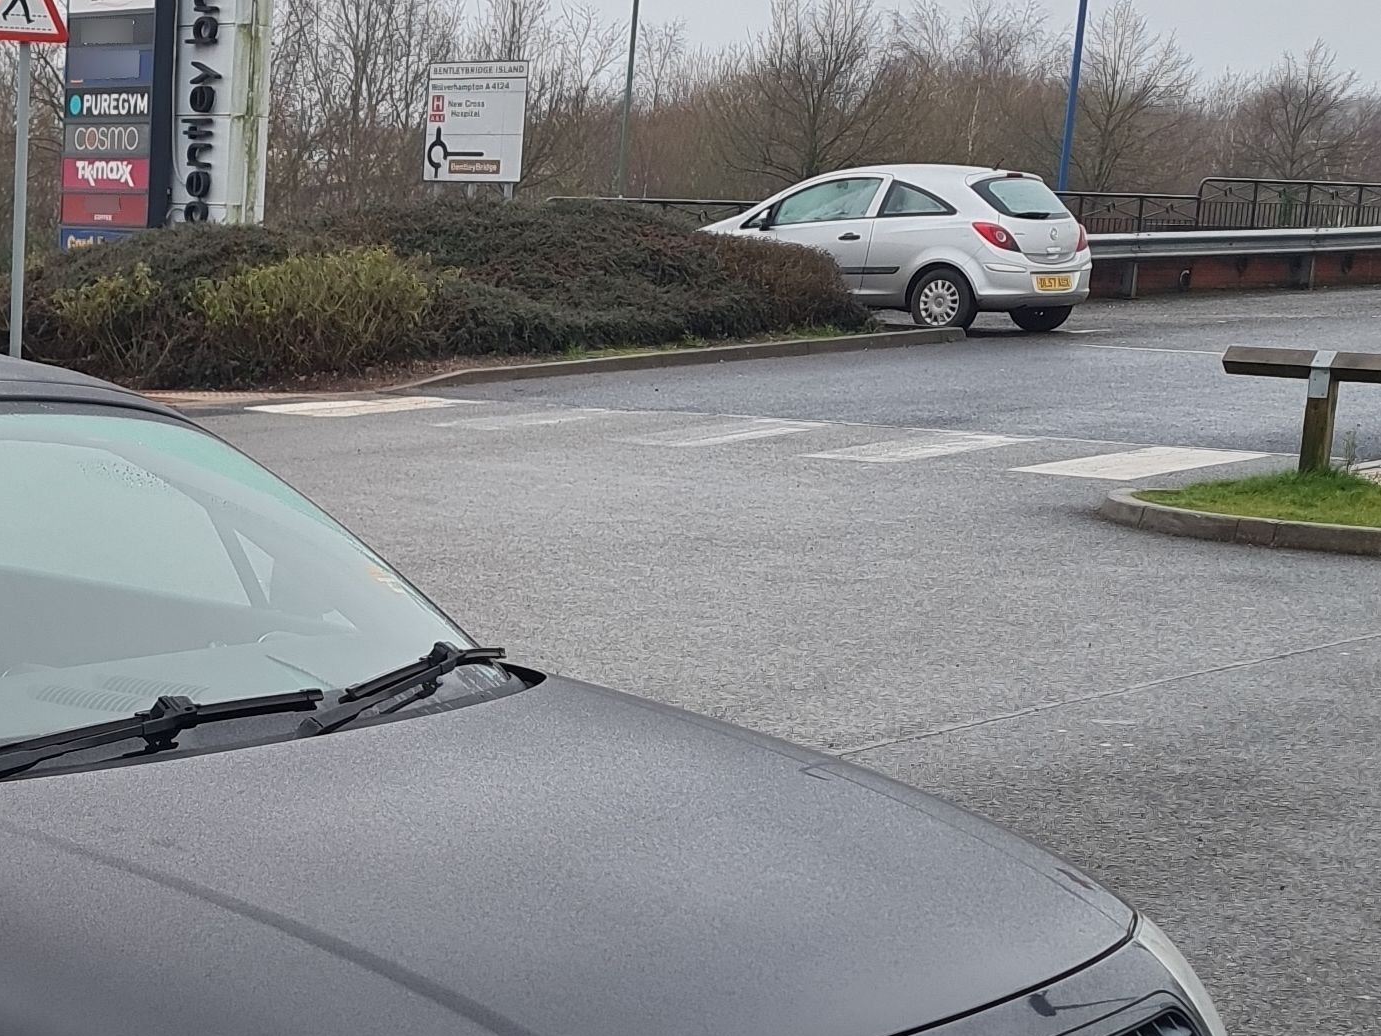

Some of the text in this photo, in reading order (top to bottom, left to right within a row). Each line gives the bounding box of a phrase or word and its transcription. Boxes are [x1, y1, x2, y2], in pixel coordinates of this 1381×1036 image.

[495, 65, 525, 74] ISLAND
[83, 93, 148, 115] PUREGYM
[465, 100, 485, 108] Cross
[451, 110, 480, 118] Hospital
[74, 126, 139, 150] COSMO
